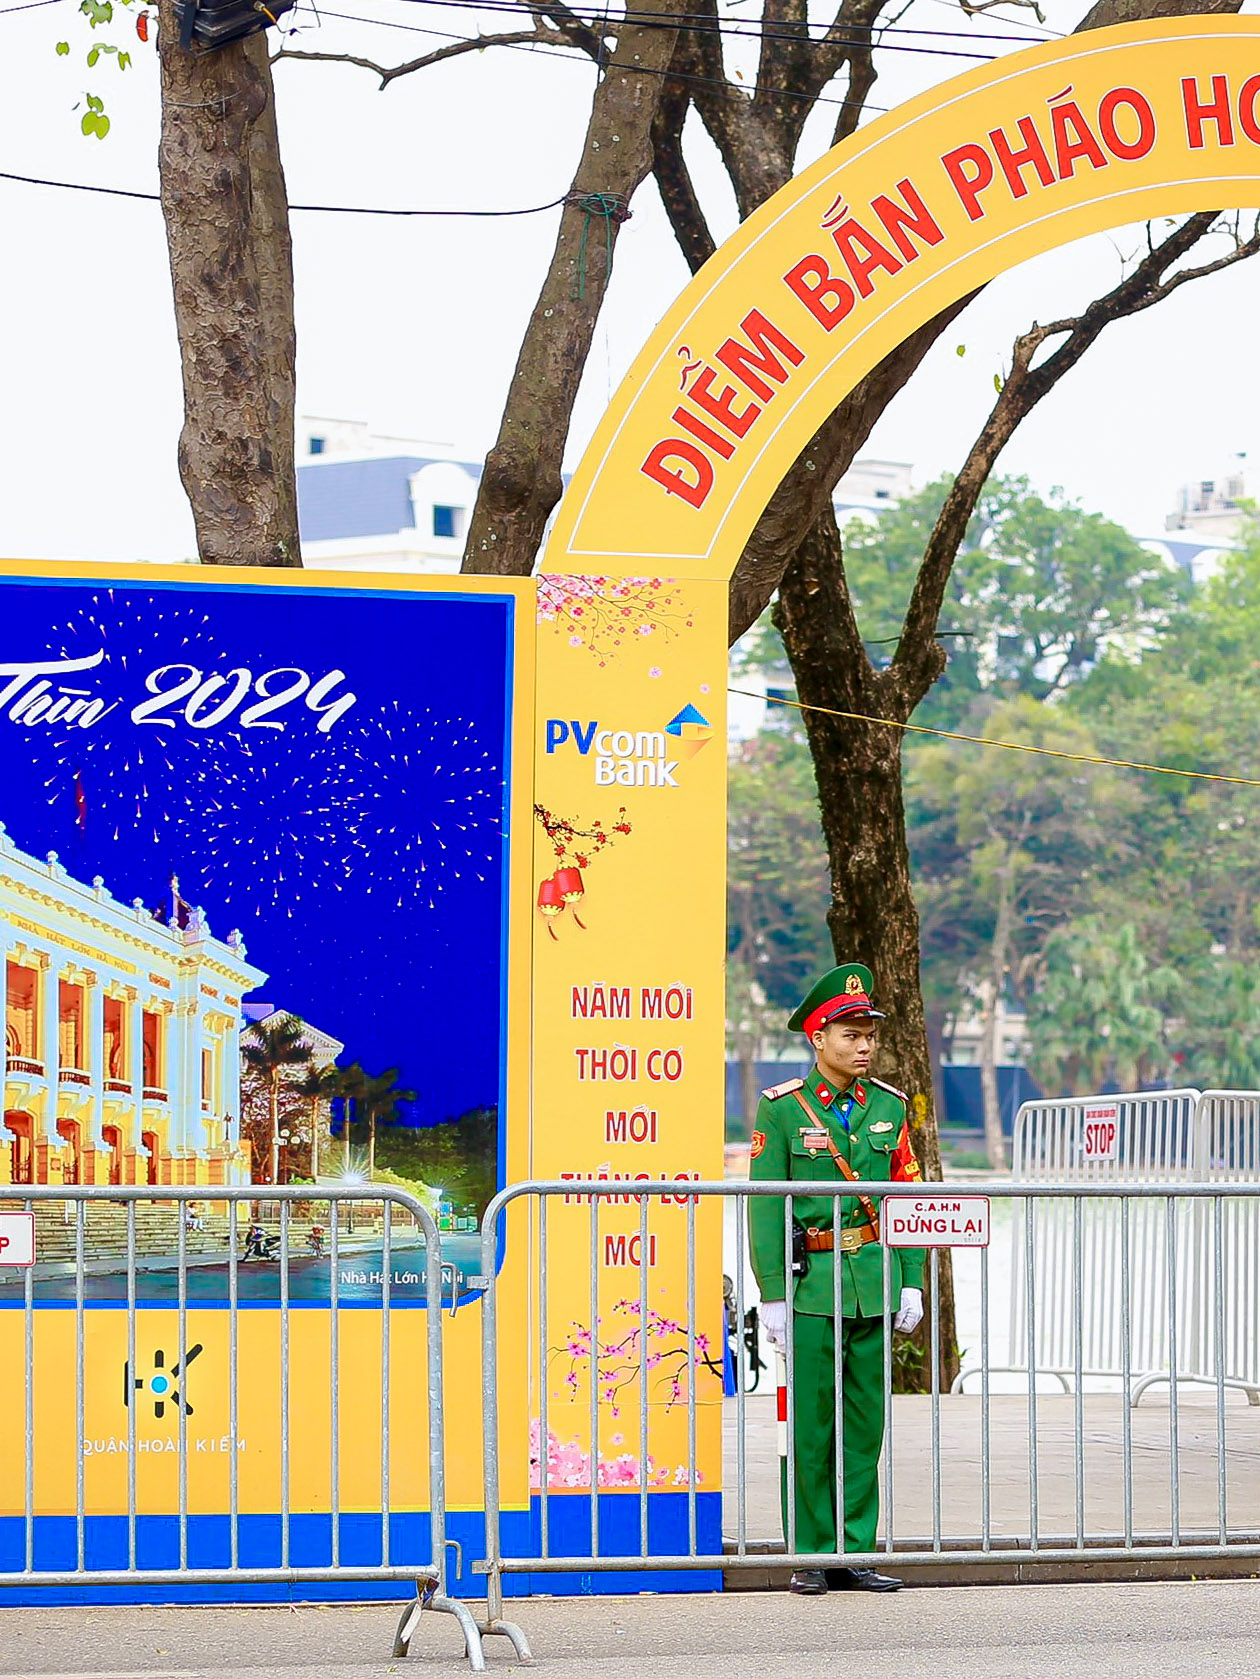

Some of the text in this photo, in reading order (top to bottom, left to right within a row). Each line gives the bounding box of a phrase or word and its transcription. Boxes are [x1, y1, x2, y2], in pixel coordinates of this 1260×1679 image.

[639, 307, 806, 509] ĐIỂM
[783, 177, 945, 332] BẮN
[940, 85, 1156, 222] PHÁO
[131, 663, 357, 733] 2024
[546, 718, 666, 758] PVcom
[595, 757, 680, 787] Bank
[572, 981, 692, 1020] NĂM MỚI
[575, 1043, 683, 1081] THỜI CƠ
[606, 1105, 657, 1143] MỚI
[1086, 1123, 1116, 1155] STOP
[893, 1213, 983, 1237] DỪNG LẠI
[914, 1202, 961, 1212] C.A.H.N
[341, 1271, 367, 1284] Nhà
[394, 1270, 419, 1284] Lớn
